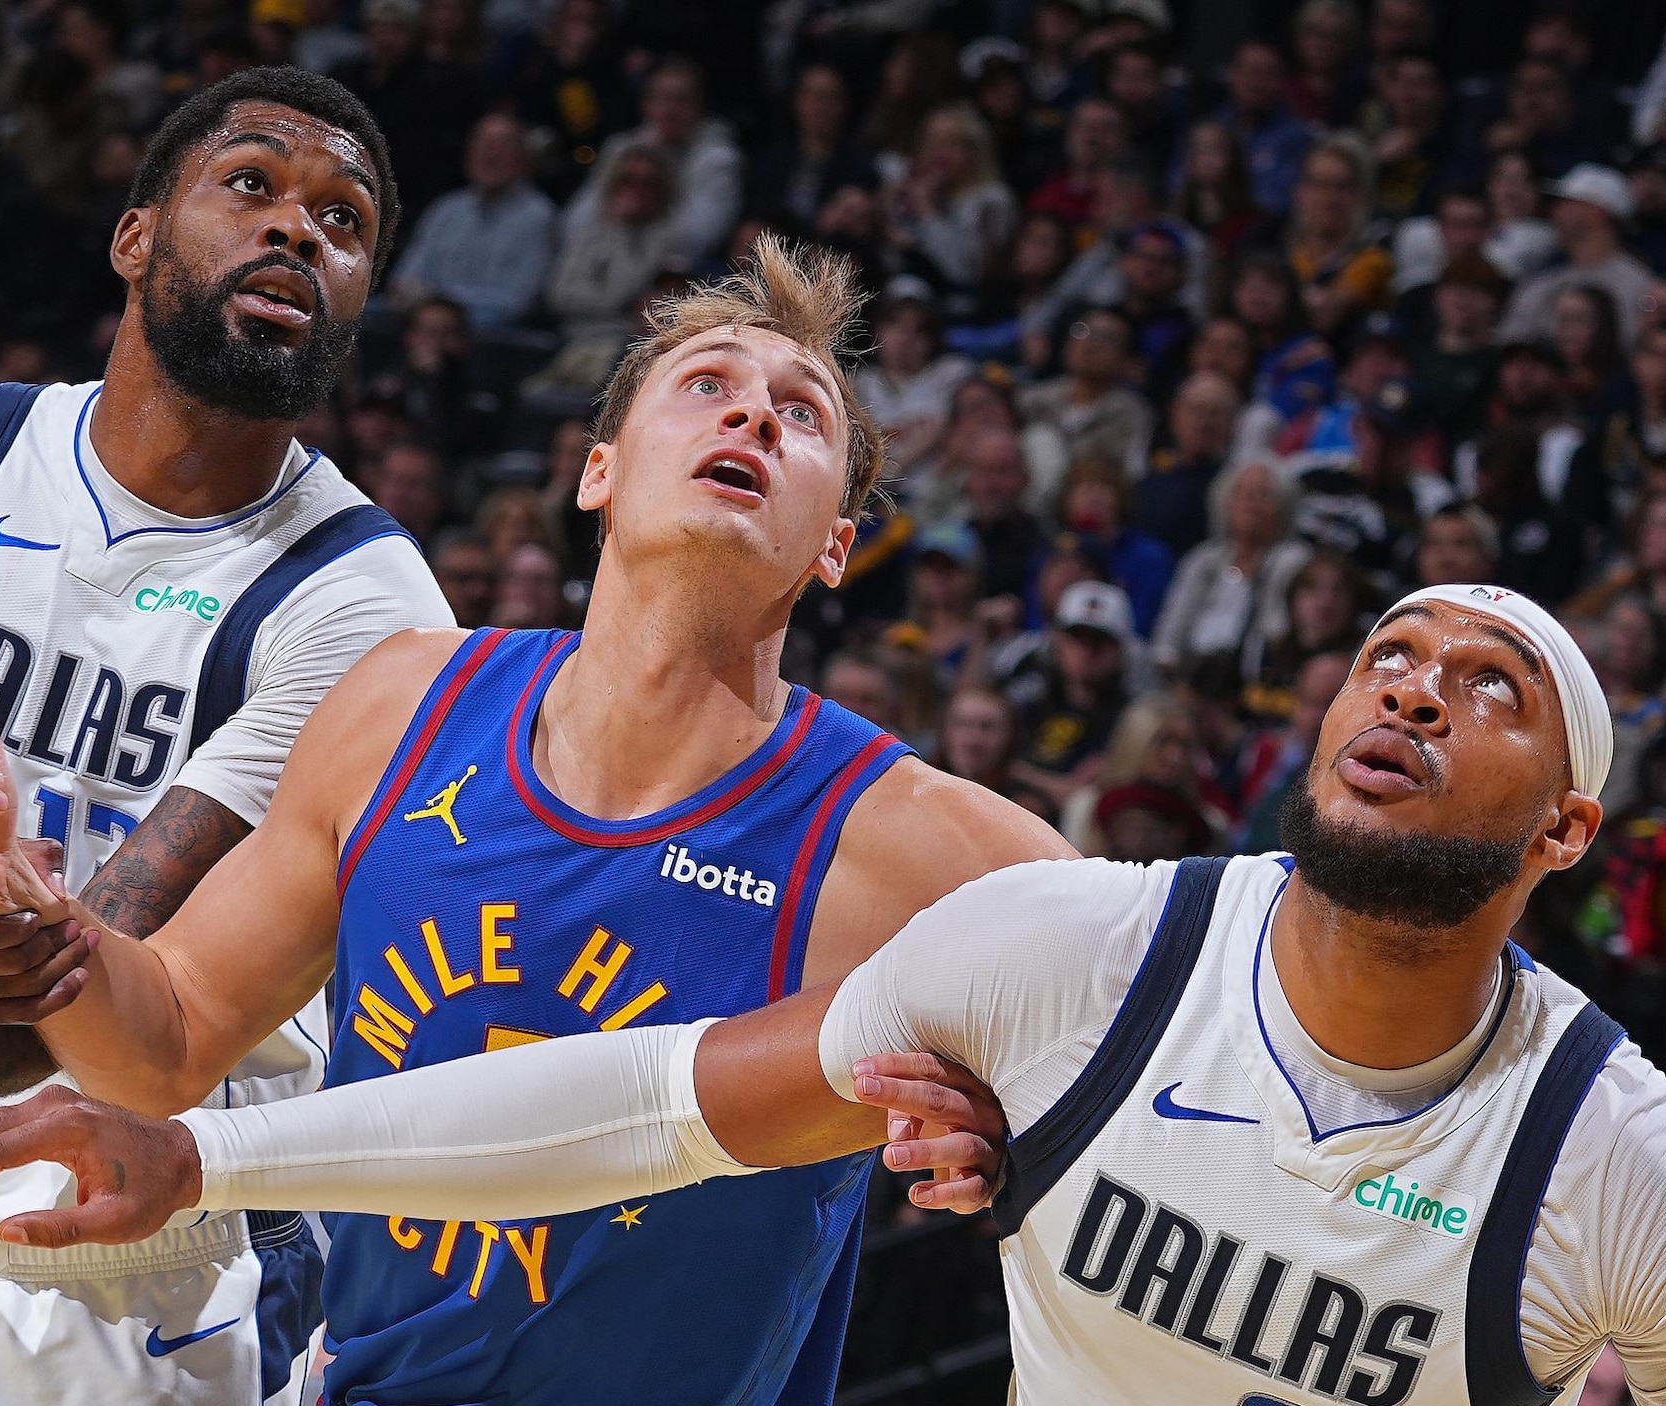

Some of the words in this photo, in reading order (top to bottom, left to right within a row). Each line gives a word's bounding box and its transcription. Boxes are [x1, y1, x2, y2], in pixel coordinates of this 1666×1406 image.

[135, 585, 221, 621] chme
[660, 843, 777, 907] ibotta
[351, 901, 522, 1069] MILE
[556, 925, 670, 1031] HI
[1355, 1174, 1468, 1237] chime
